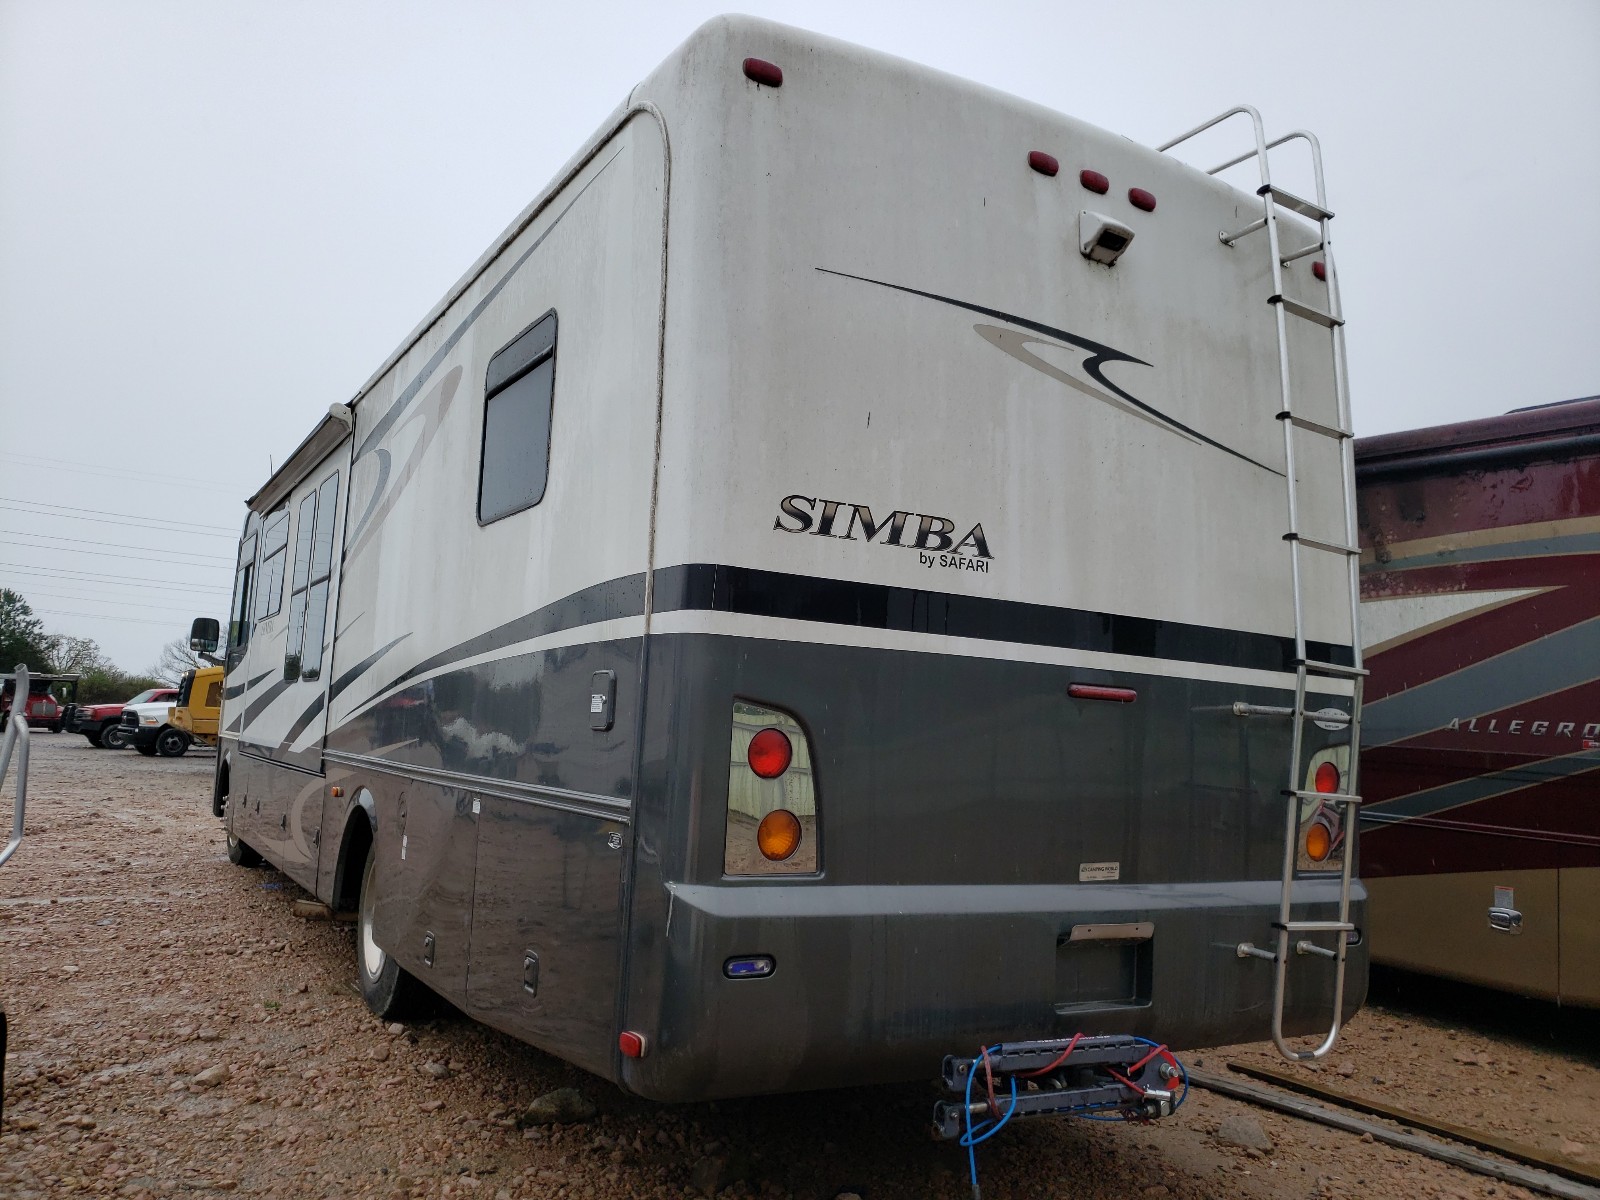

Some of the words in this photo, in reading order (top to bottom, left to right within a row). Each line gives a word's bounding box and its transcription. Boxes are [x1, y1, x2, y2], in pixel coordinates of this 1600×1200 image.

[773, 494, 995, 560] SIMBA
[919, 552, 935, 568] by
[939, 554, 989, 573] SAFARI
[1445, 717, 1600, 738] ALLEGRO
